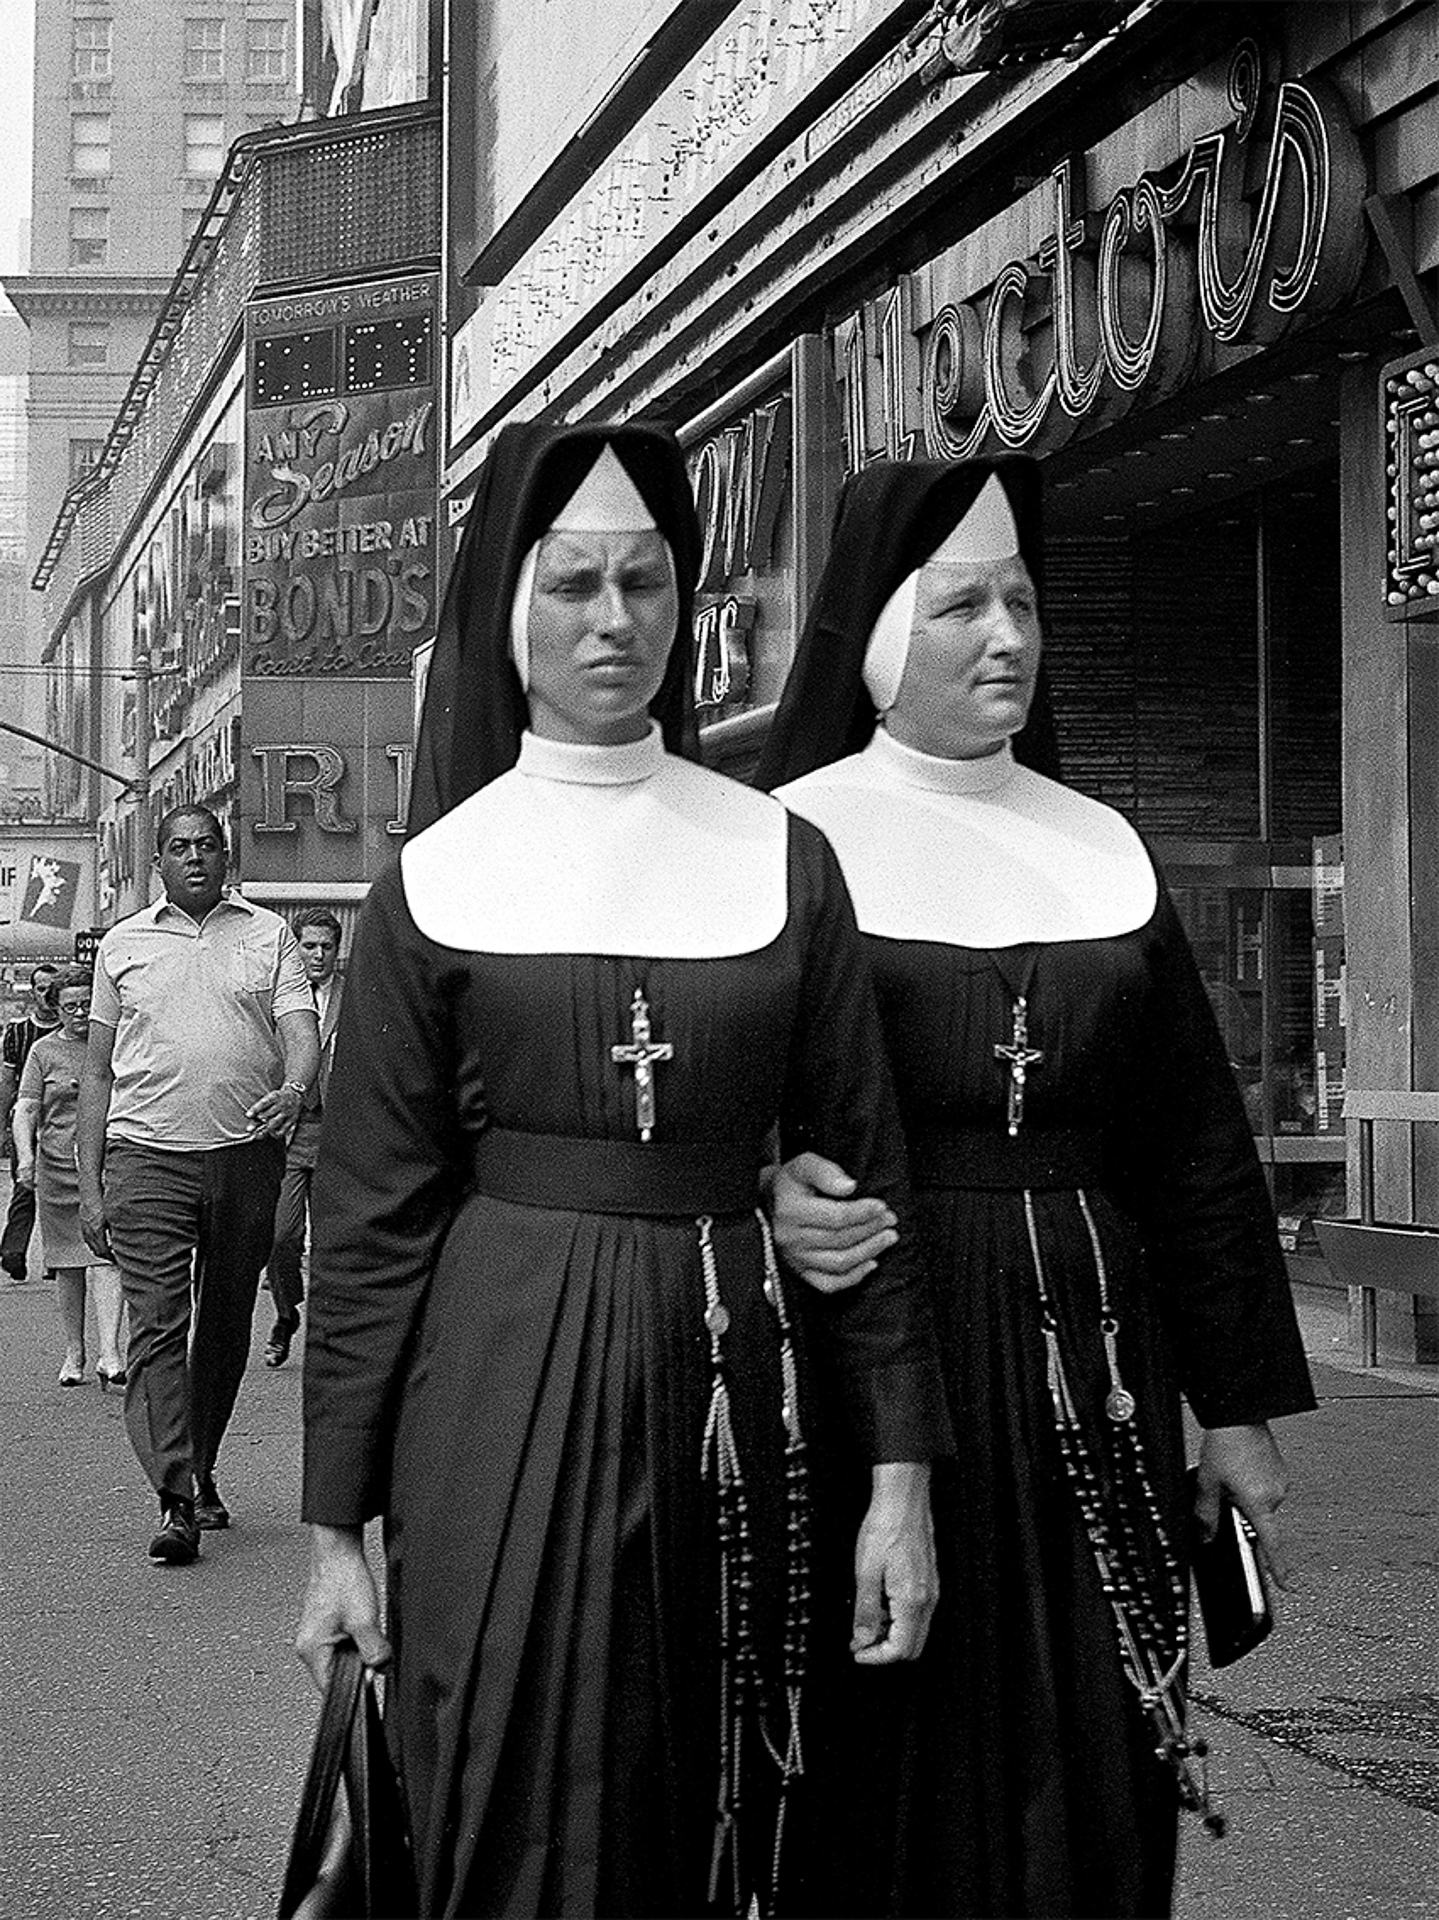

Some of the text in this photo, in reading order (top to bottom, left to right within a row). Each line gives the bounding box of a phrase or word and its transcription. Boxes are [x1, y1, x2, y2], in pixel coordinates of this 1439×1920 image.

[252, 282, 430, 325] TOMORROW'S WEATHER
[251, 401, 432, 530] Season
[253, 426, 323, 464] ANY
[248, 516, 433, 564] BUY BETTER AT
